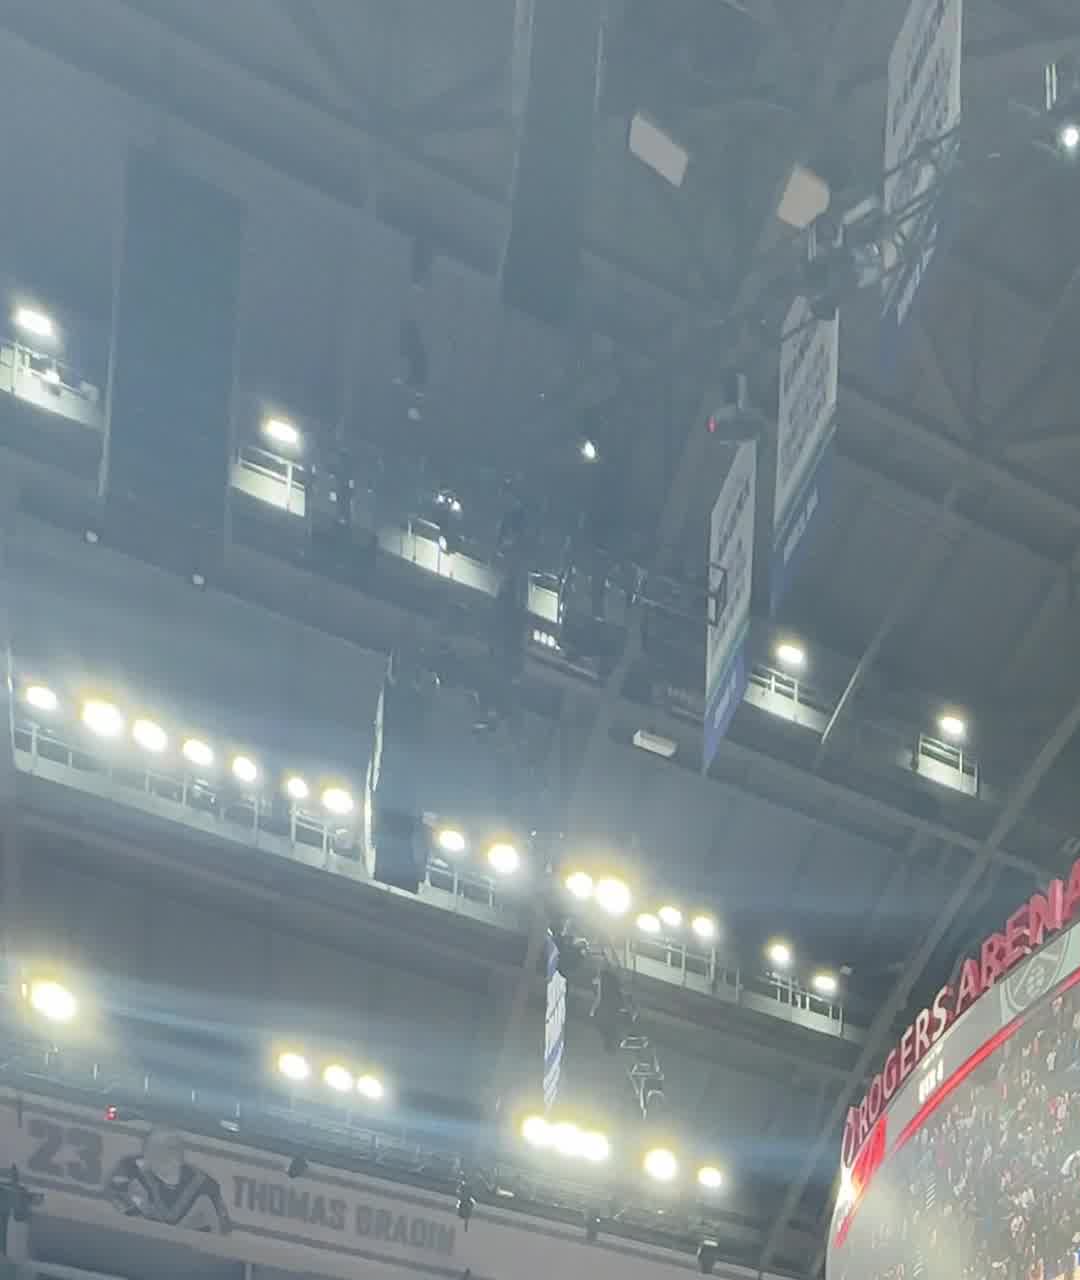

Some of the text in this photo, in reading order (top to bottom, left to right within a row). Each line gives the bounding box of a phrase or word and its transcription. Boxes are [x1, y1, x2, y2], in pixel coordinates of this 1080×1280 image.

[857, 984, 957, 1144] ROGERS
[27, 1118, 102, 1183] 23
[232, 1175, 457, 1256] THOMAS GRADIN
